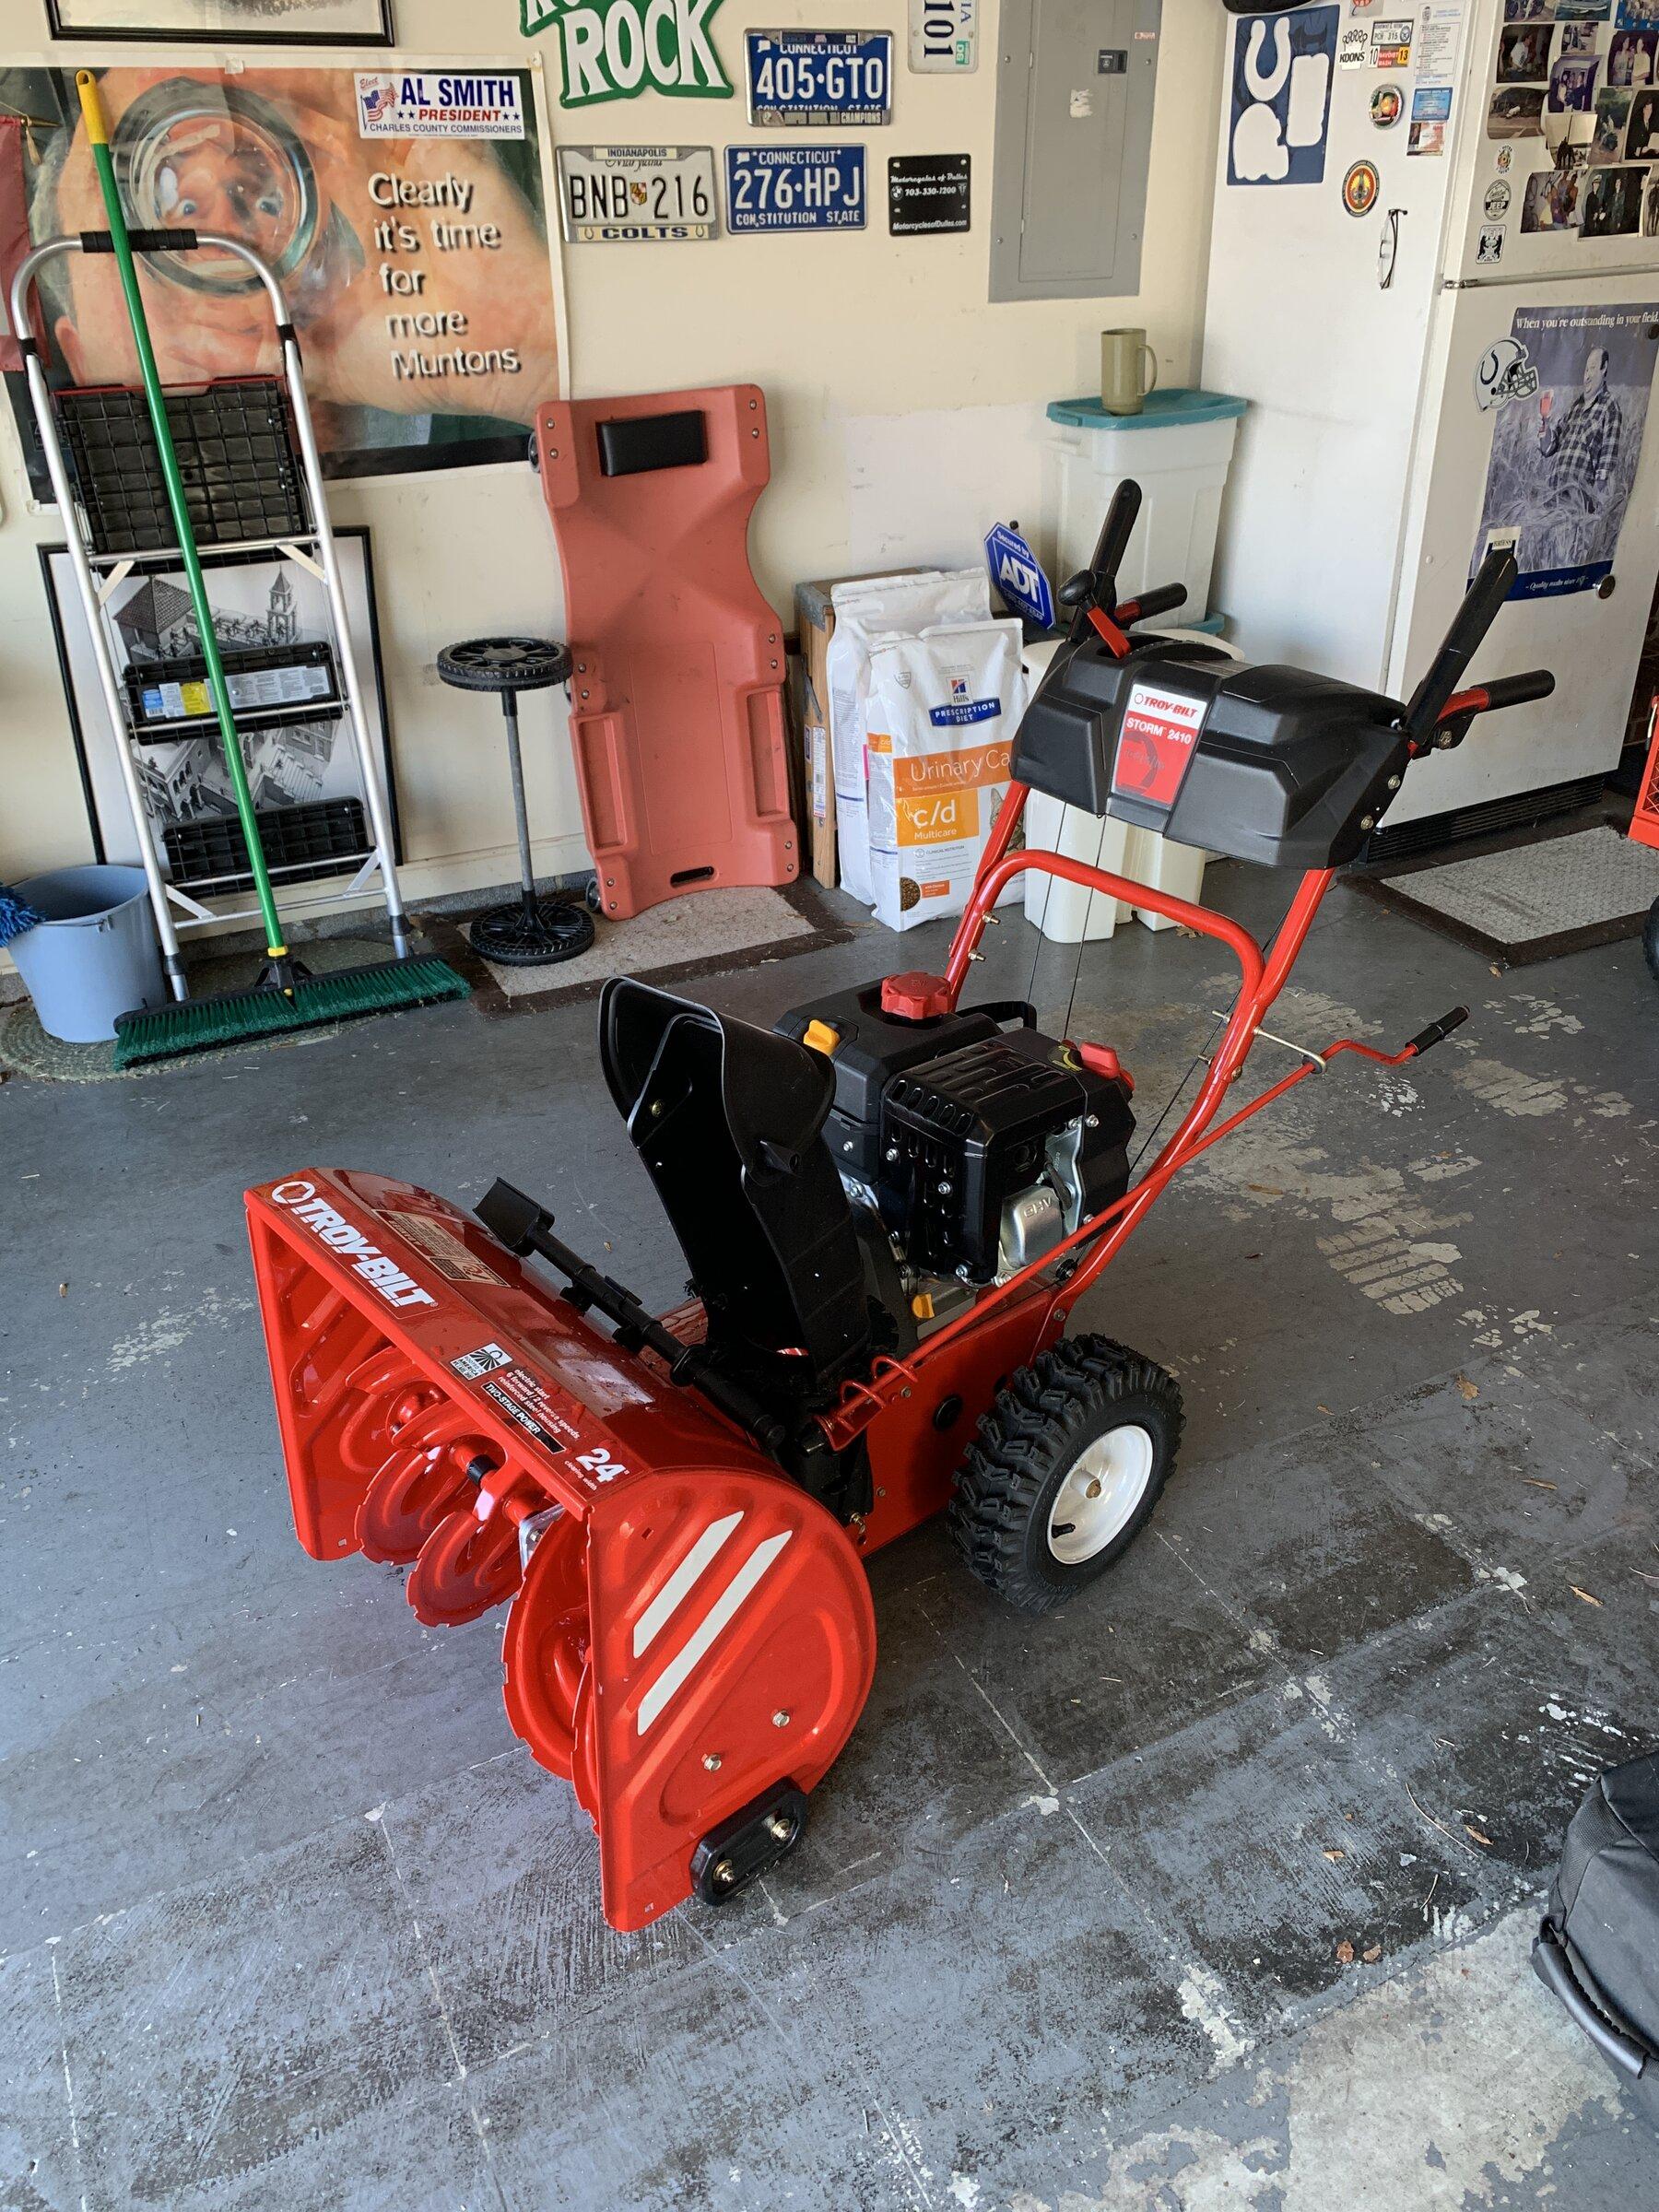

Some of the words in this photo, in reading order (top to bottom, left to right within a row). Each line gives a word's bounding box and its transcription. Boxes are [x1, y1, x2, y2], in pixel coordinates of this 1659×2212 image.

[560, 0, 728, 100] ROCK
[359, 76, 378, 89] Elect
[401, 77, 430, 106] AL
[438, 78, 514, 107] SMITH
[370, 124, 410, 133] CHARLES
[413, 124, 449, 133] COUNTY
[451, 124, 522, 134] COMMISSIONERS
[418, 109, 501, 122] PRESIDENT
[841, 112, 881, 124] CHAMPIONS
[607, 148, 667, 157] INDIANAPOLIS
[759, 150, 836, 165] CONNECTICUT
[368, 171, 472, 213] Clearly
[570, 175, 629, 218] BNB
[652, 175, 708, 218] 216
[904, 186, 957, 196] 703-330-1200
[736, 211, 817, 226] CONSTITUTION
[826, 210, 860, 224] STATE
[373, 216, 418, 250] it's
[430, 217, 500, 249] time
[602, 227, 688, 239] COLTS
[379, 263, 425, 295] for
[385, 310, 467, 335] more
[1517, 317, 1539, 329] When
[1541, 317, 1567, 331] you're
[1571, 314, 1615, 328] outstanding
[1617, 313, 1624, 324] in
[1625, 315, 1641, 326] your
[391, 347, 521, 379] Muntons
[996, 530, 1021, 553] Secured
[1021, 547, 1030, 559] by
[1000, 552, 1039, 603] ADT
[935, 702, 995, 718] PRESCRIPTION
[953, 694, 969, 703] Hill's
[1143, 697, 1198, 718] TROY-BILT
[956, 714, 973, 723] DIET
[1126, 717, 1163, 736] STORM
[1167, 729, 1192, 745] 2410
[911, 756, 982, 782] Urinary
[913, 799, 956, 828] c/d
[914, 829, 957, 840] Multicare
[290, 1198, 436, 1308] TROY-BILT
[514, 1369, 535, 1388] electric
[535, 1385, 550, 1400] start
[485, 1383, 521, 1416] TWO-STAGE
[516, 1412, 541, 1434] POWER
[498, 1376, 528, 1402] reinforced
[524, 1400, 538, 1415] steel
[537, 1412, 561, 1434] housing
[510, 1374, 534, 1398] forward
[536, 1401, 559, 1421] reverse
[558, 1418, 581, 1440] speeds
[565, 1460, 584, 1479] clearing
[582, 1477, 597, 1491] width
